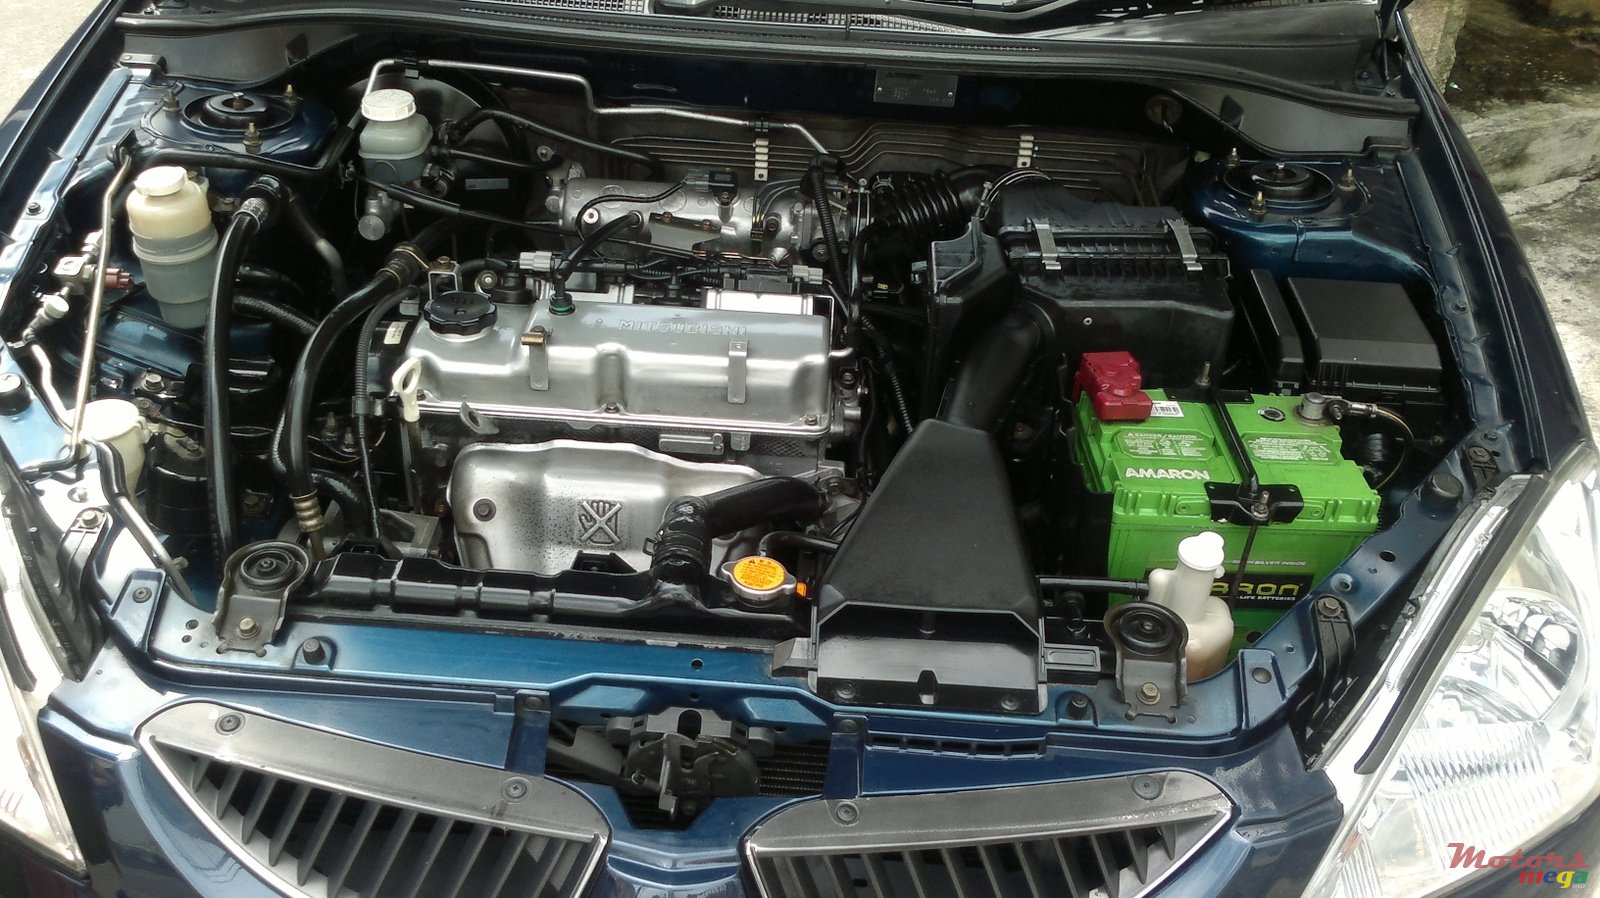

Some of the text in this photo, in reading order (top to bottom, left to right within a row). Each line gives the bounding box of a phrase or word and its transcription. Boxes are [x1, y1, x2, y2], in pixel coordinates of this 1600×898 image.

[618, 319, 748, 336] MITSUBISHI
[1125, 467, 1211, 480] AMARON
[1212, 582, 1300, 596] ARON
